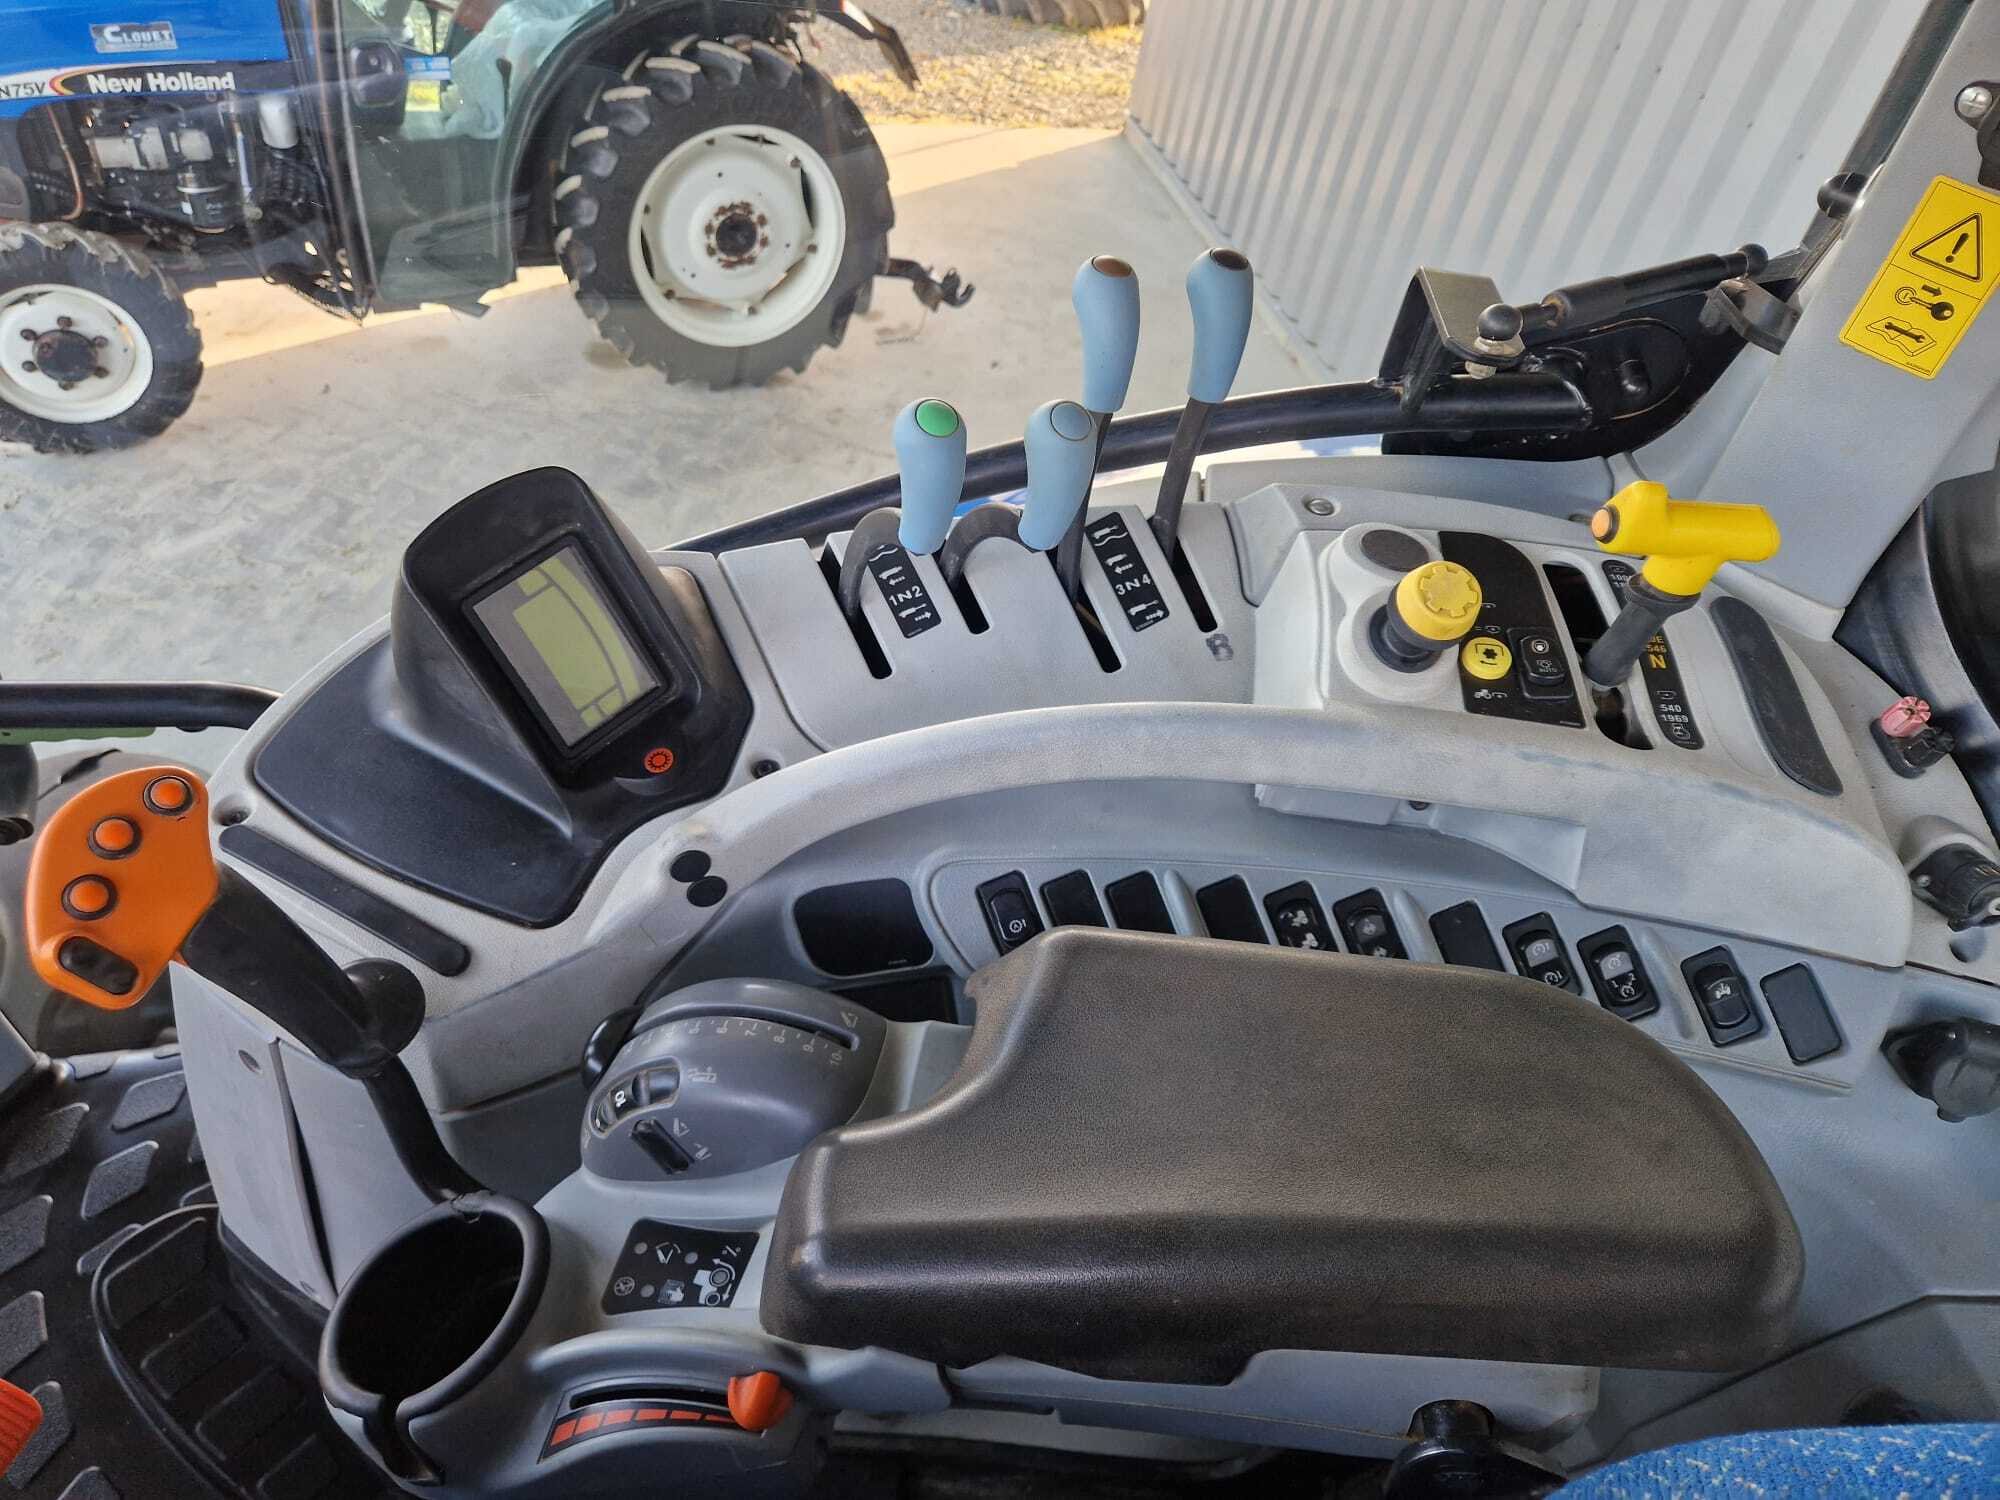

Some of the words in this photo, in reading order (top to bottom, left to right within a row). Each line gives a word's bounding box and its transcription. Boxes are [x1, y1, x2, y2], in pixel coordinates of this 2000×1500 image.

[86, 73, 142, 93] New
[147, 71, 236, 92] Holland
[1650, 654, 1667, 669] N
[1660, 703, 1682, 713] 540
